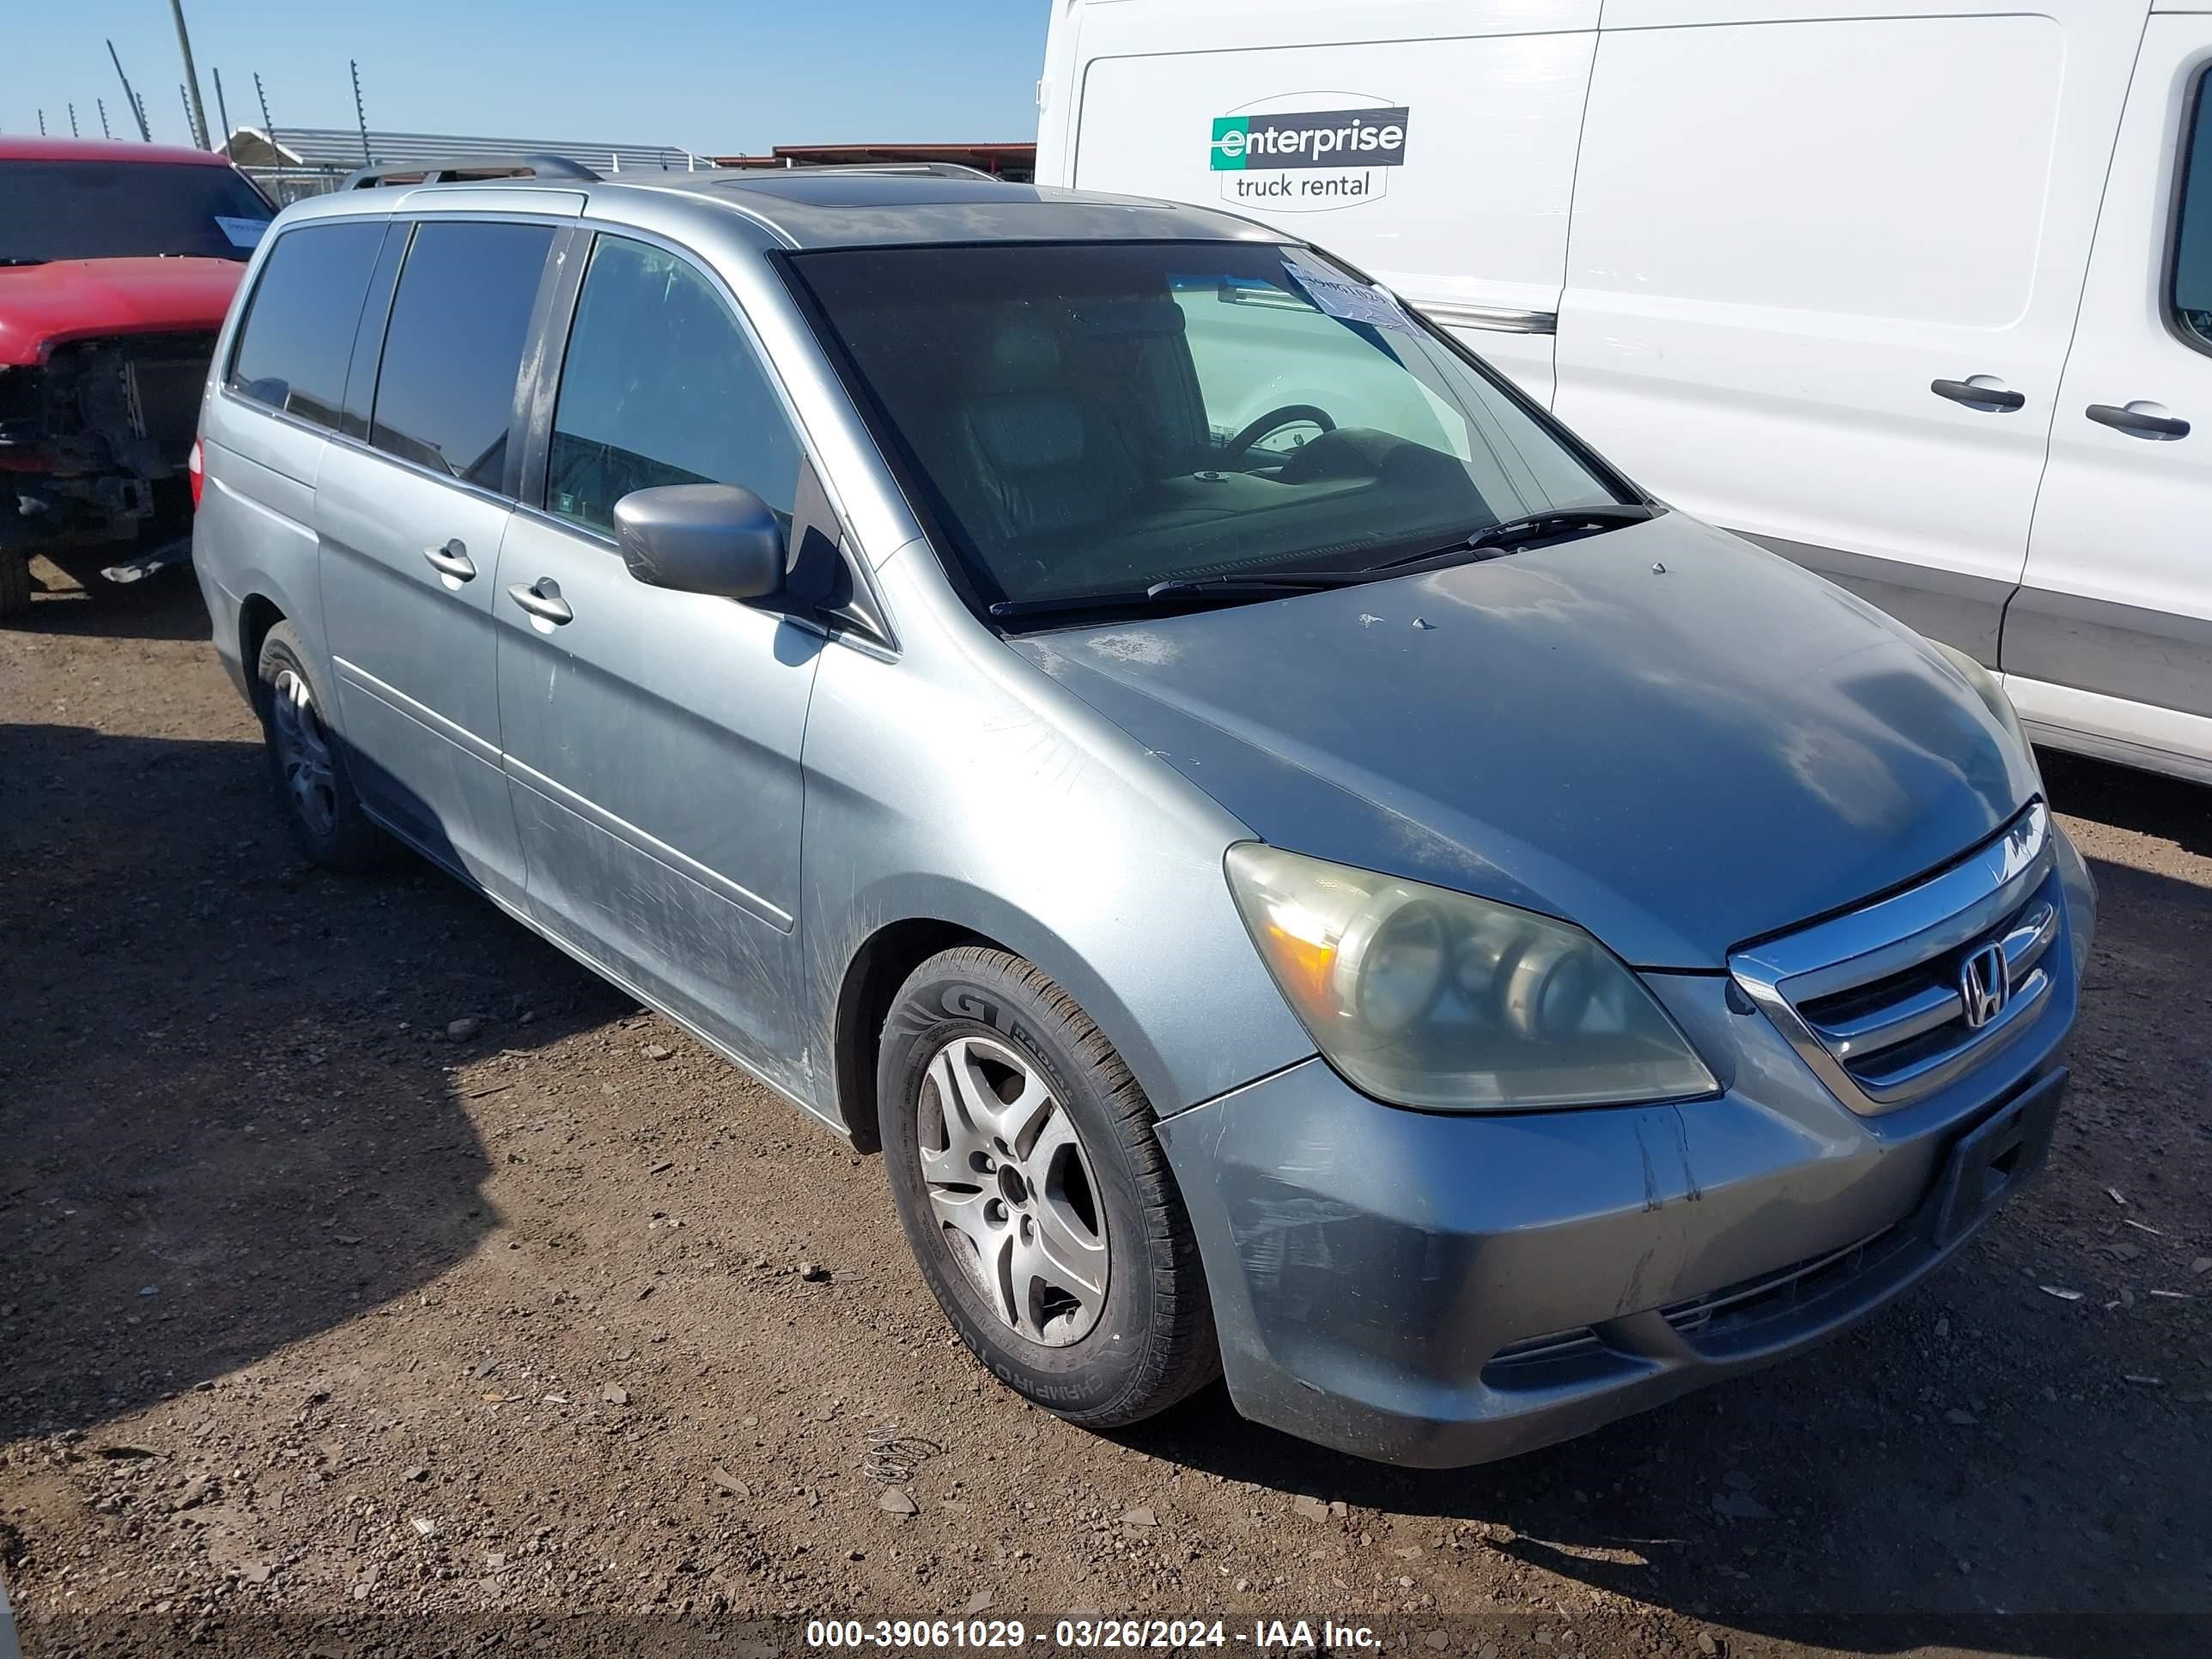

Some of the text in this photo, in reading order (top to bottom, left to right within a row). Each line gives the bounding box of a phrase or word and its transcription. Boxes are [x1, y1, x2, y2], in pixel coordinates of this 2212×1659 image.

[1219, 118, 1404, 161] enterprise
[1237, 171, 1370, 197] truck rental
[940, 984, 1073, 1099] GT RADIAL
